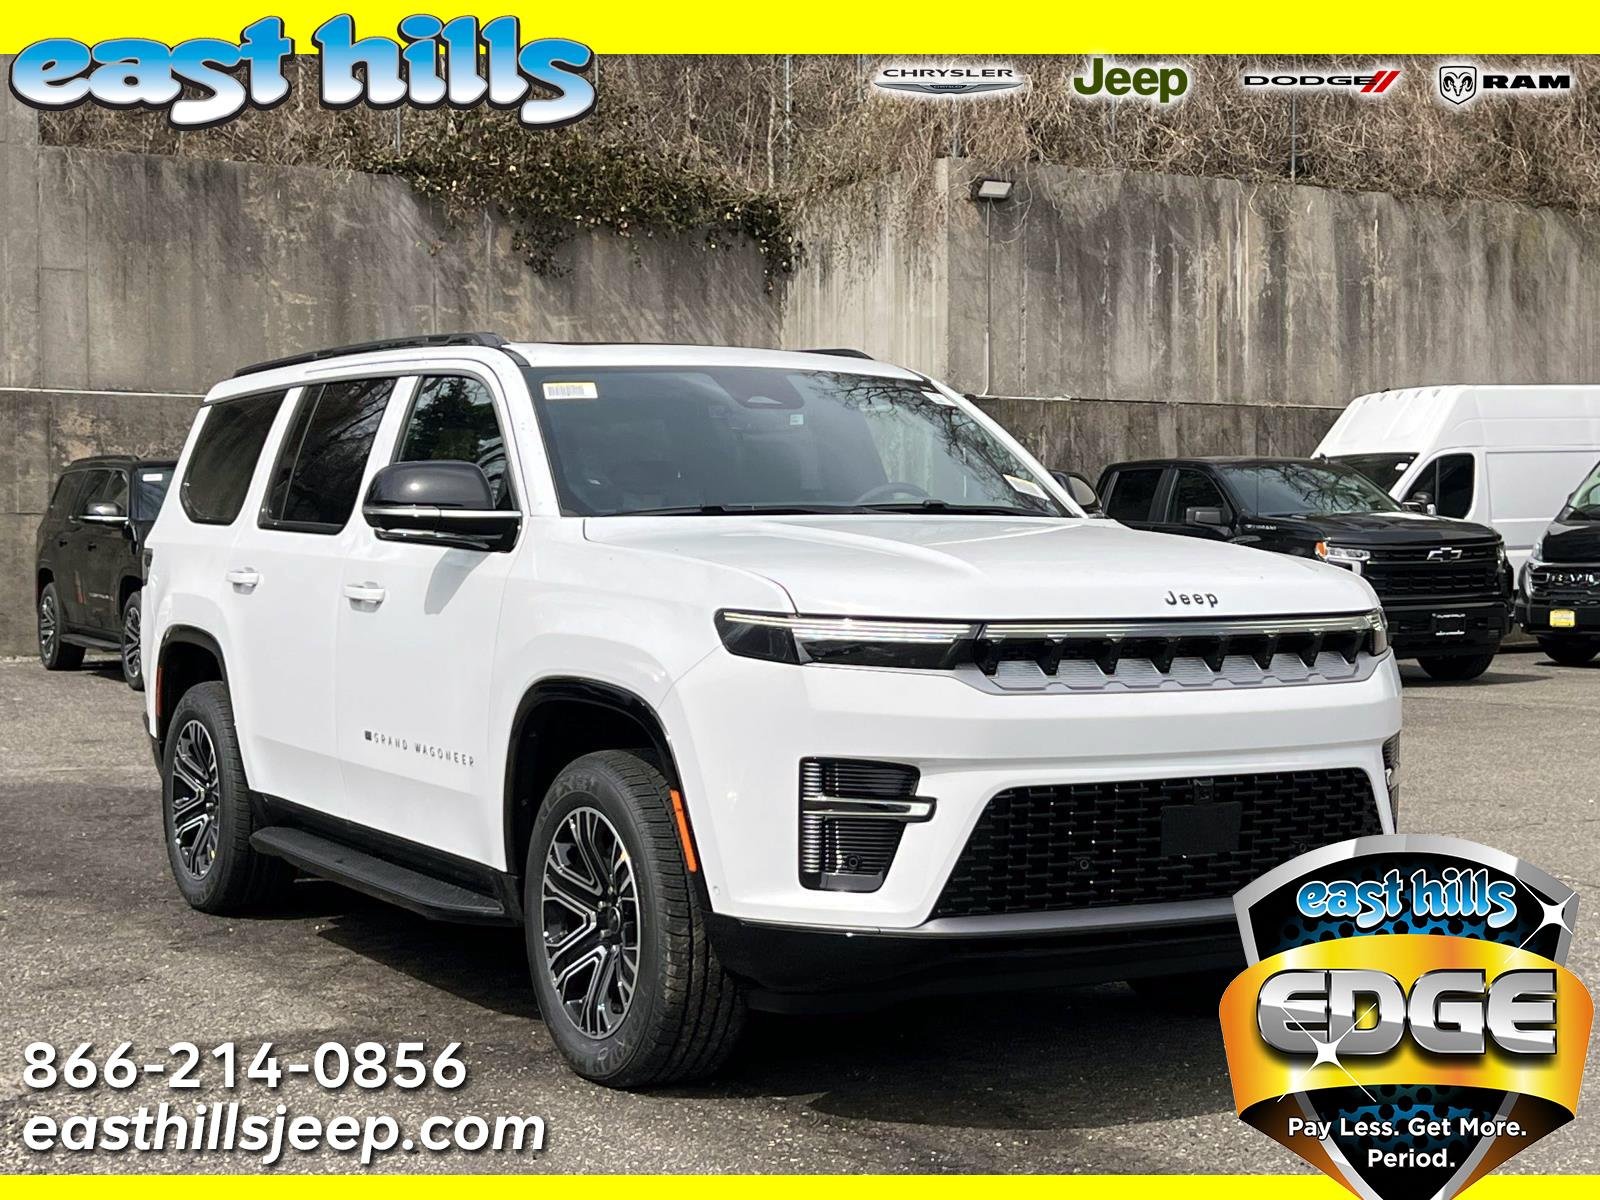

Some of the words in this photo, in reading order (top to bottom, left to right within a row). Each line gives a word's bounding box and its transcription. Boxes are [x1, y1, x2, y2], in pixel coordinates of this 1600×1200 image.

[1165, 590, 1219, 608] Jeep
[373, 732, 408, 750] GRAND
[415, 743, 474, 766] WAGONEER
